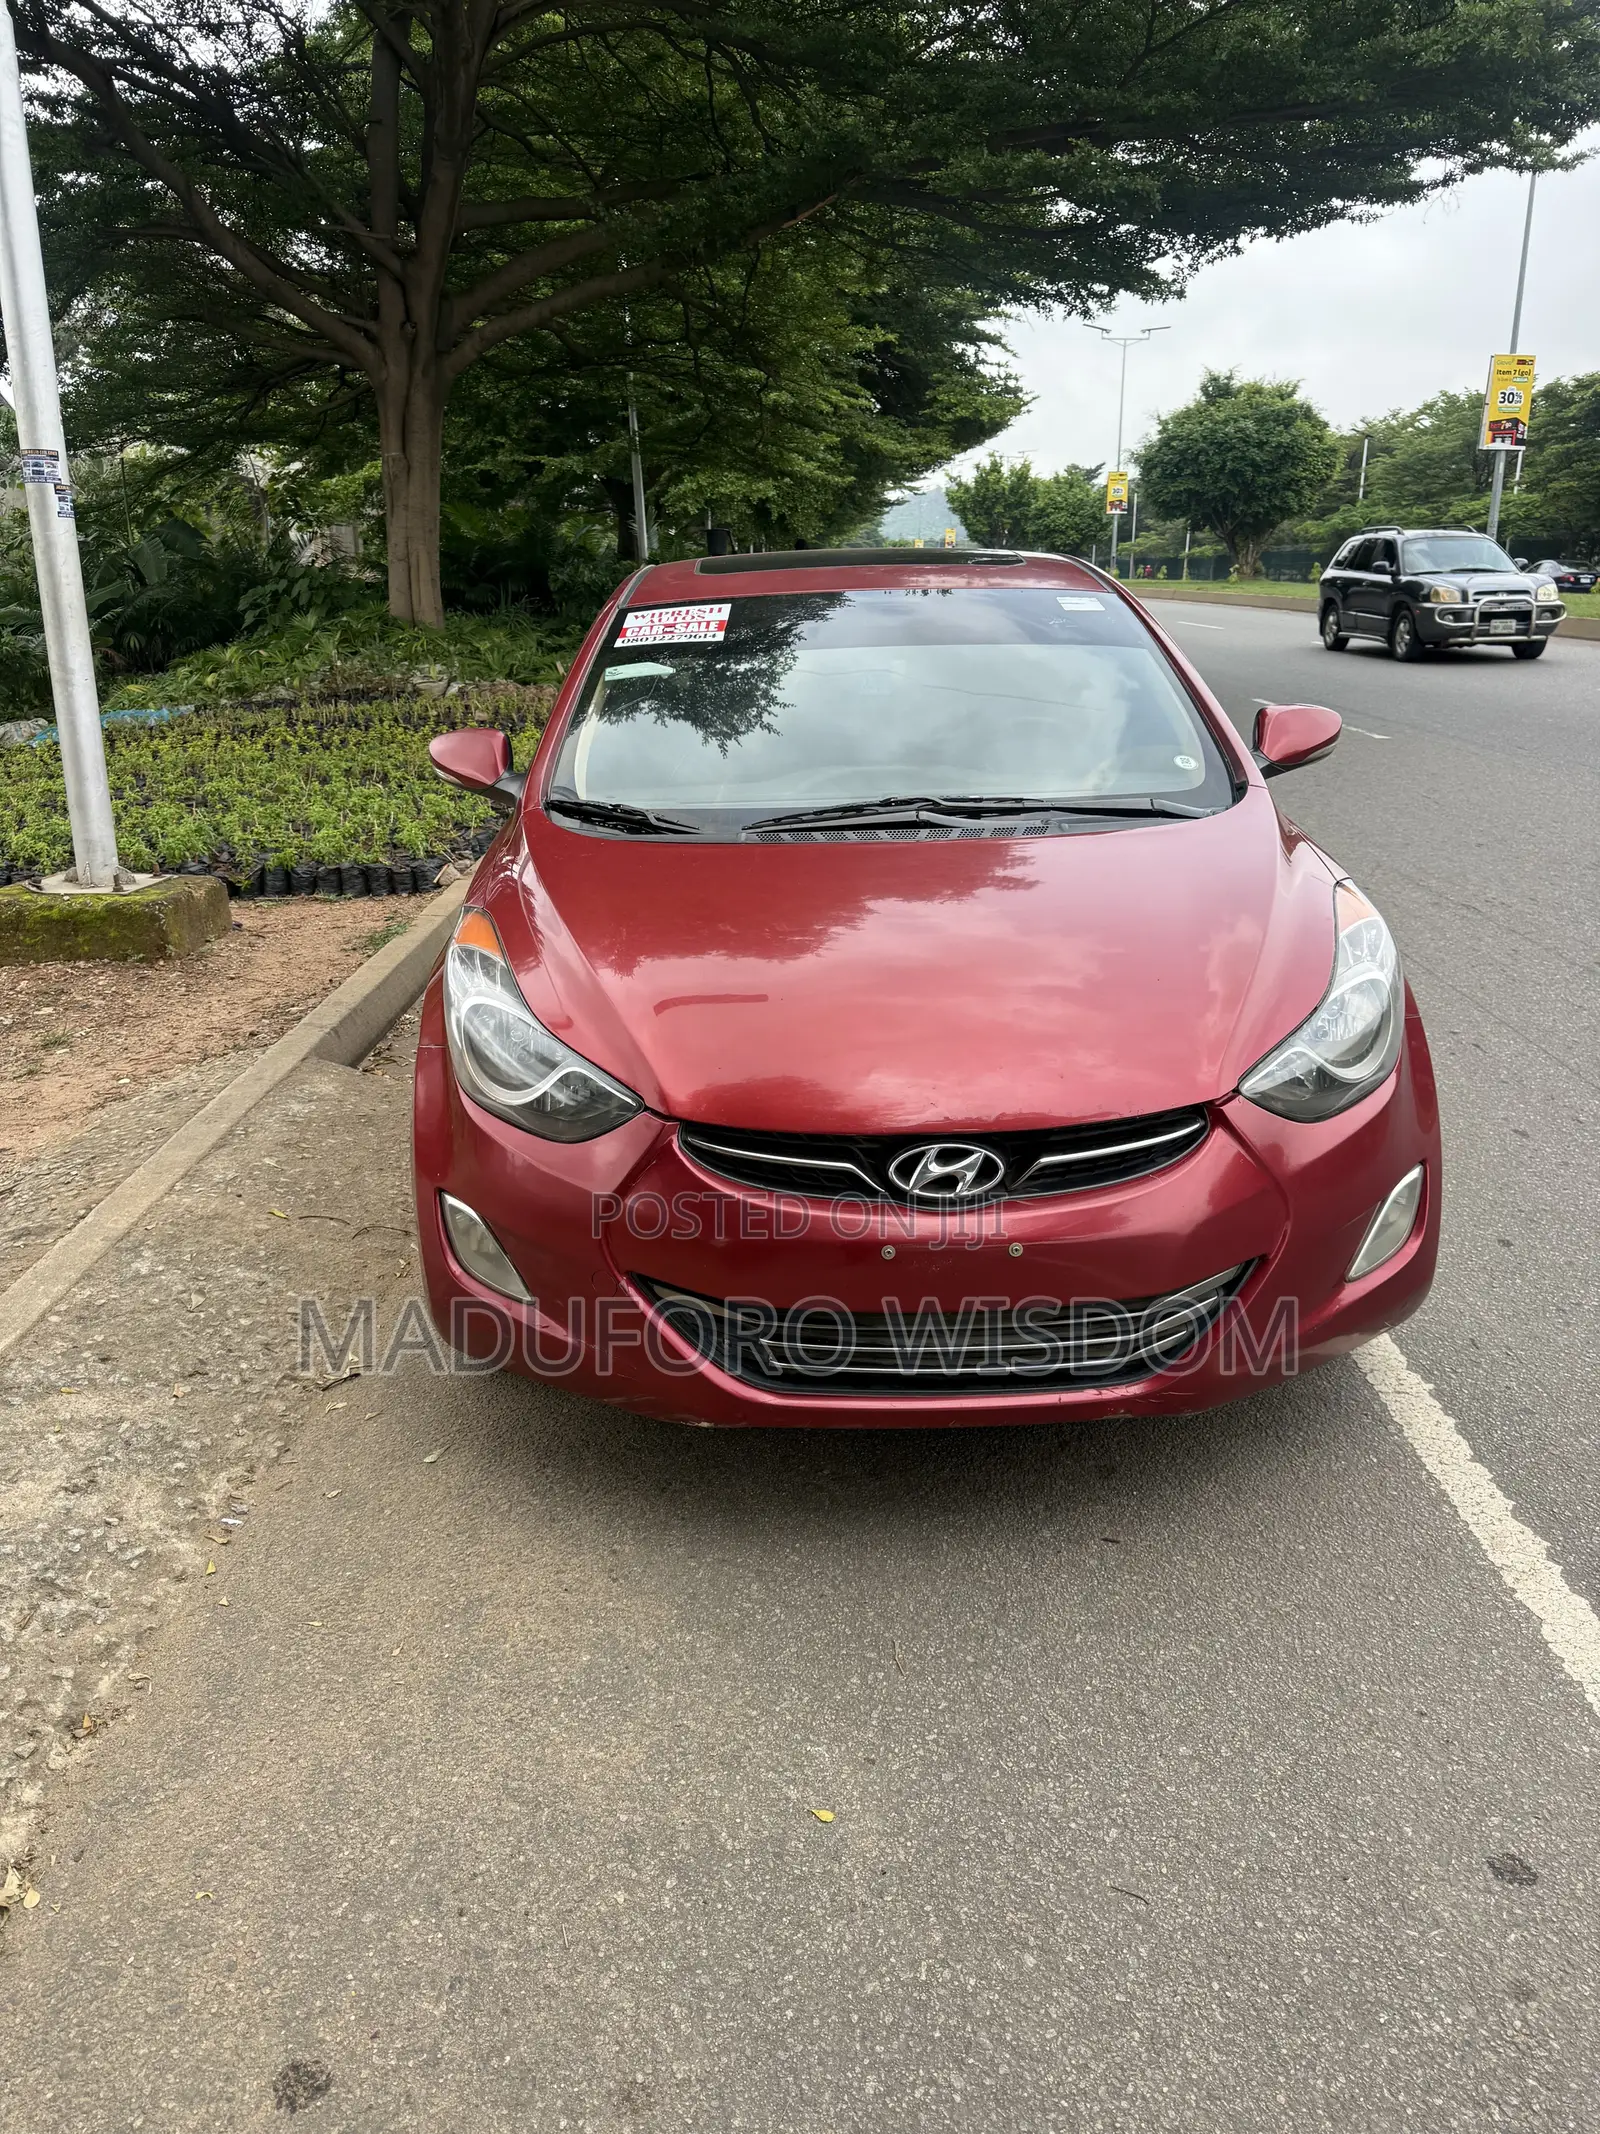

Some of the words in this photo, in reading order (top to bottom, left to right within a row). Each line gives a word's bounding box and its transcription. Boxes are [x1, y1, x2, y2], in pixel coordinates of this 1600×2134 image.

[646, 615, 706, 624] AUTOS
[625, 625, 664, 637] CAR
[674, 621, 719, 633] SALE
